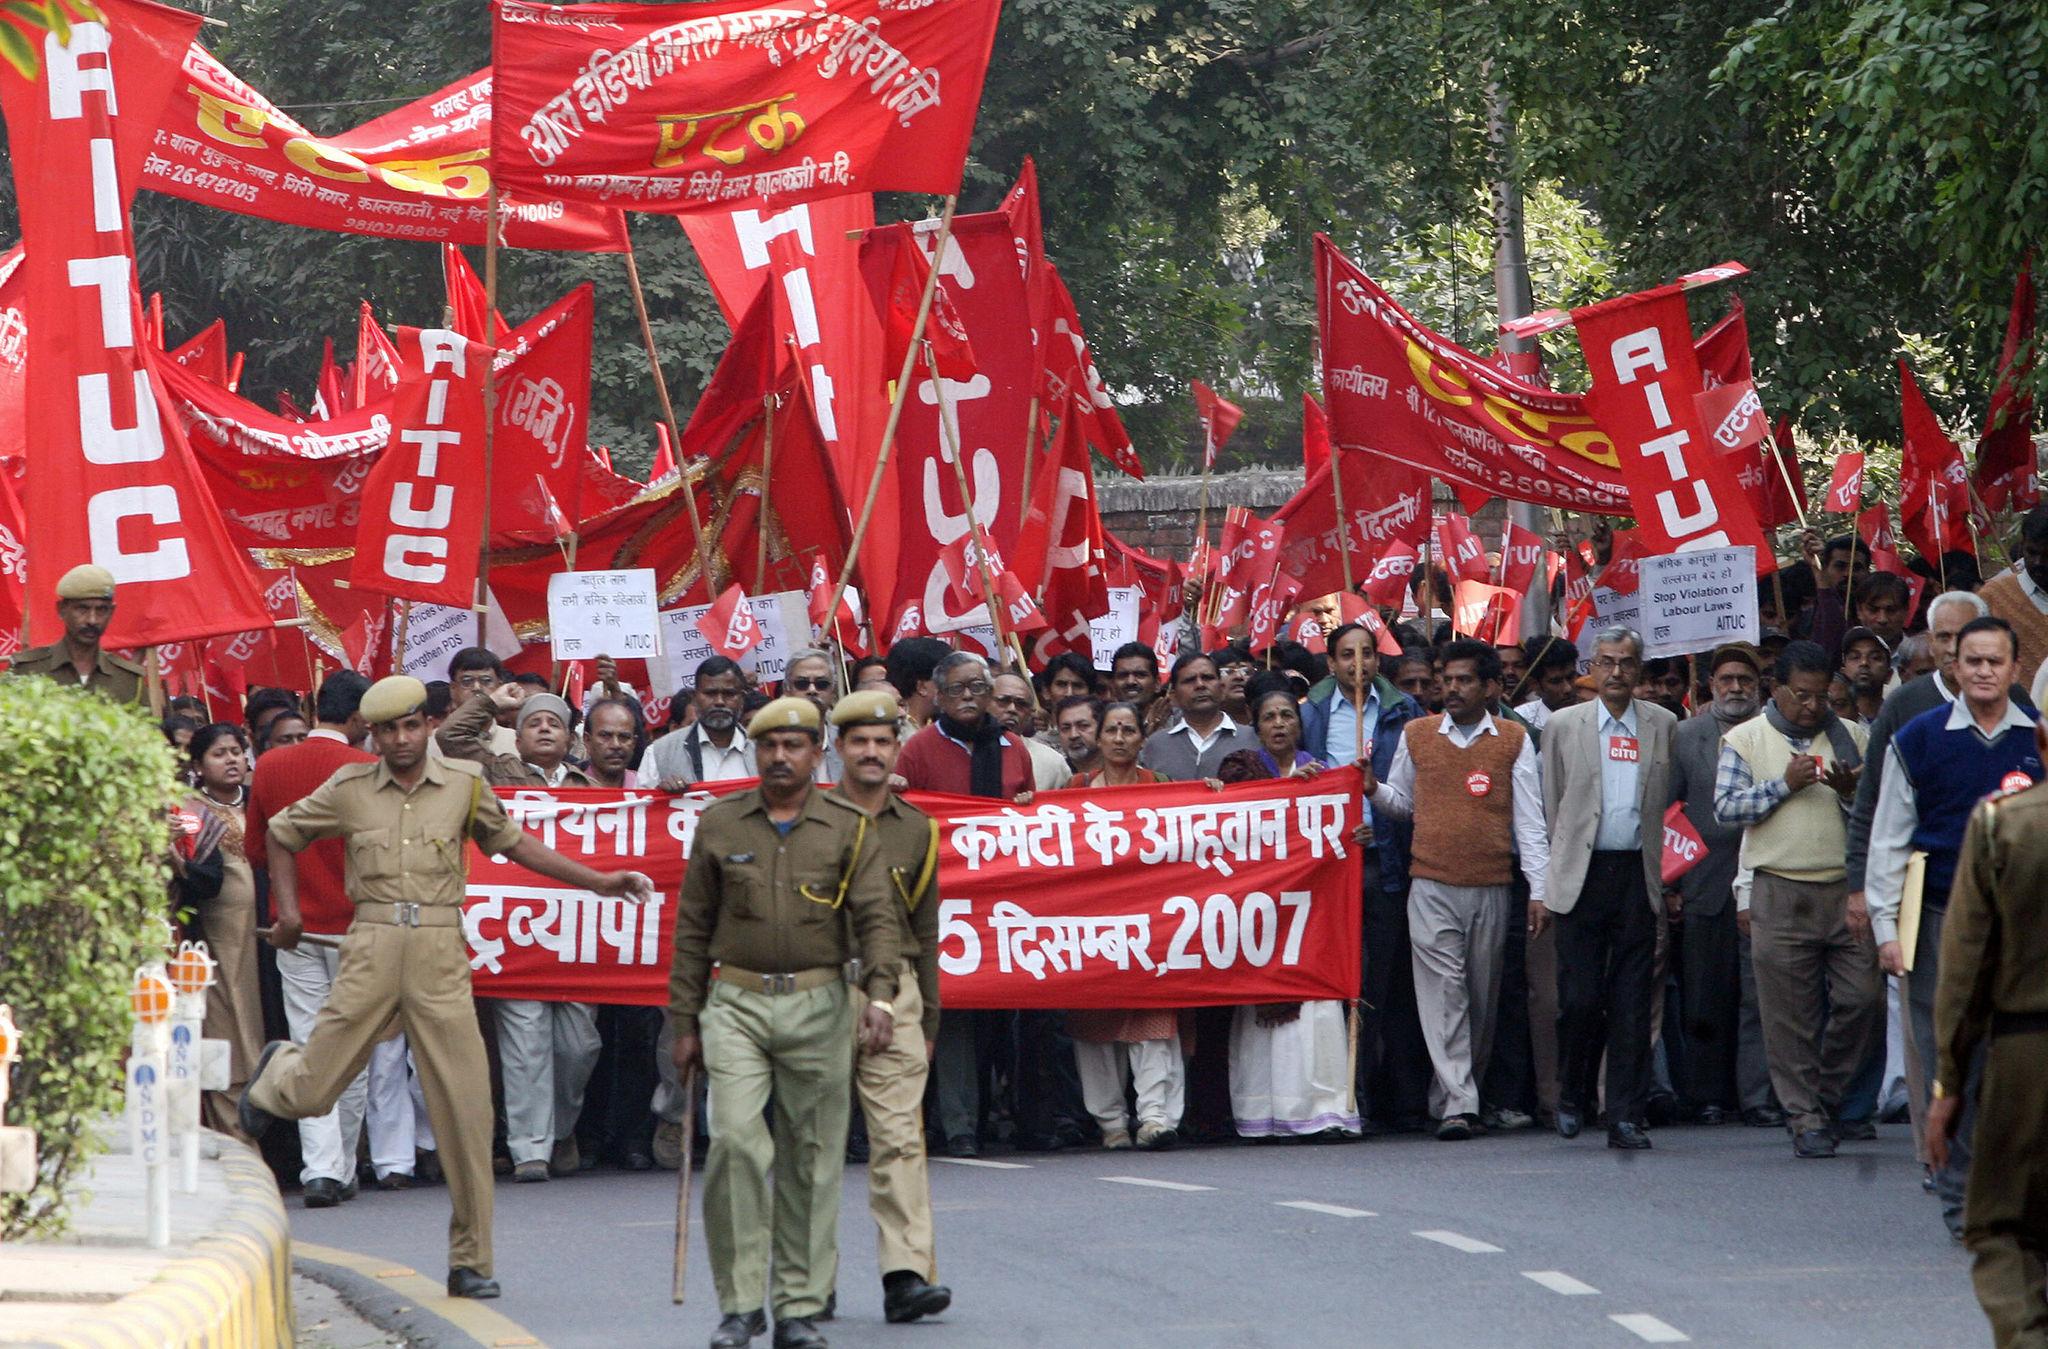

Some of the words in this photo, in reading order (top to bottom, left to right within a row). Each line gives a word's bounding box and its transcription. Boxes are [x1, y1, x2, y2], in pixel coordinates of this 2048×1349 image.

[651, 92, 807, 169] एटक
[45, 20, 191, 584] AITUC
[1611, 327, 1733, 553] AITU
[383, 329, 467, 583] AITUC
[1653, 592, 1677, 604] Stop
[1680, 585, 1728, 601] Violation
[1731, 583, 1744, 595] of
[408, 605, 437, 627] Prices
[1662, 606, 1701, 618] Labour
[1704, 601, 1733, 613] Laws
[1716, 613, 1746, 631] AITUC
[412, 610, 468, 647] Commodities
[442, 633, 464, 652] PDS
[624, 633, 651, 651] AITUC
[1610, 748, 1637, 759] CITU
[949, 803, 1076, 871] कमेटी
[1083, 801, 1131, 867] के
[1296, 792, 1351, 860] पर
[1663, 825, 1698, 862] TUC
